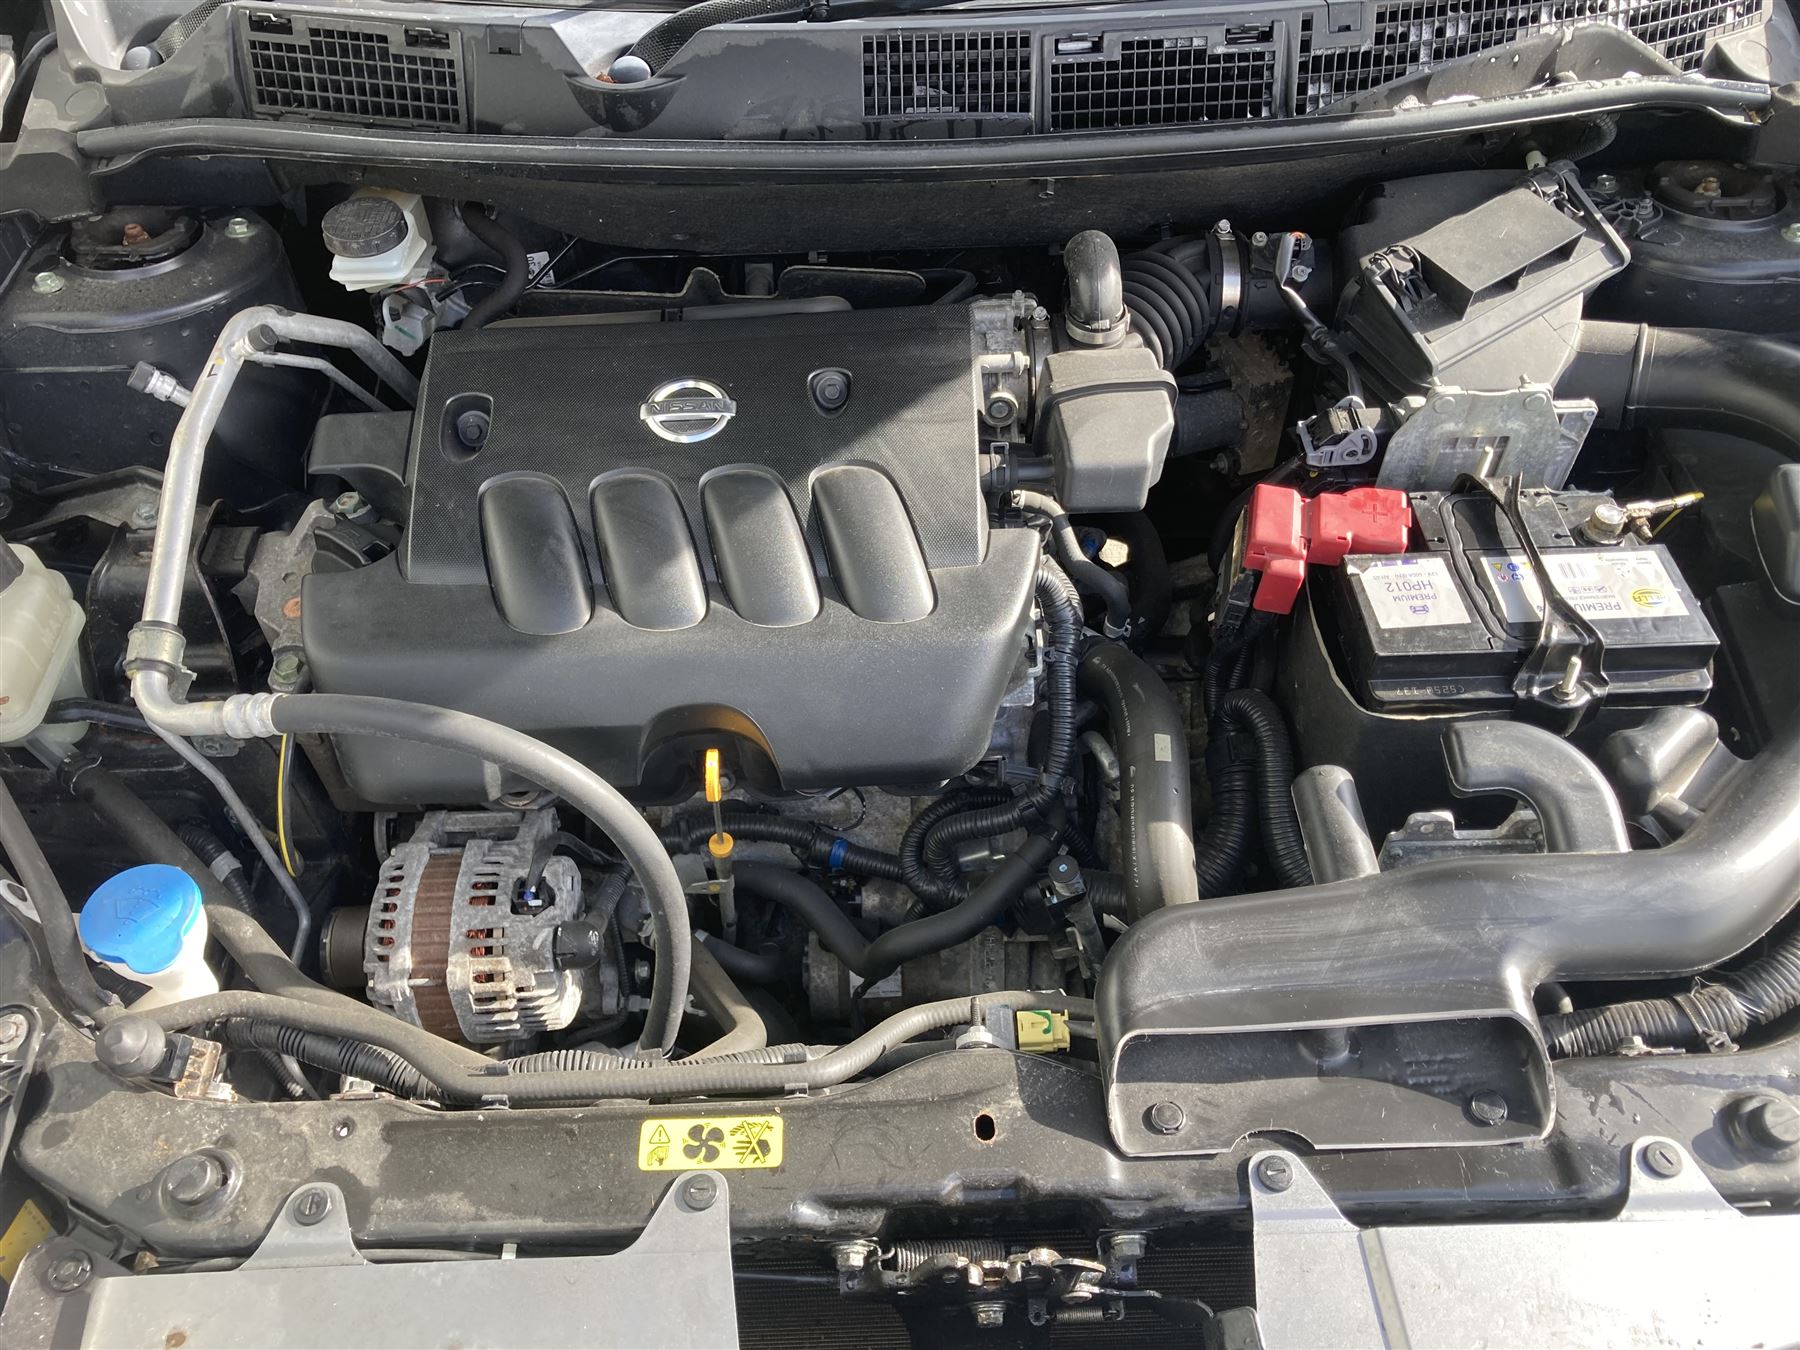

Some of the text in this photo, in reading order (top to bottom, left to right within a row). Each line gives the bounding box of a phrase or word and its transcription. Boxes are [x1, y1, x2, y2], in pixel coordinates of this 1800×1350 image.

[649, 400, 725, 414] NISSAN
[1386, 580, 1433, 593] HP012
[1392, 593, 1437, 602] PREMIUM
[1573, 602, 1621, 612] PREMIU
